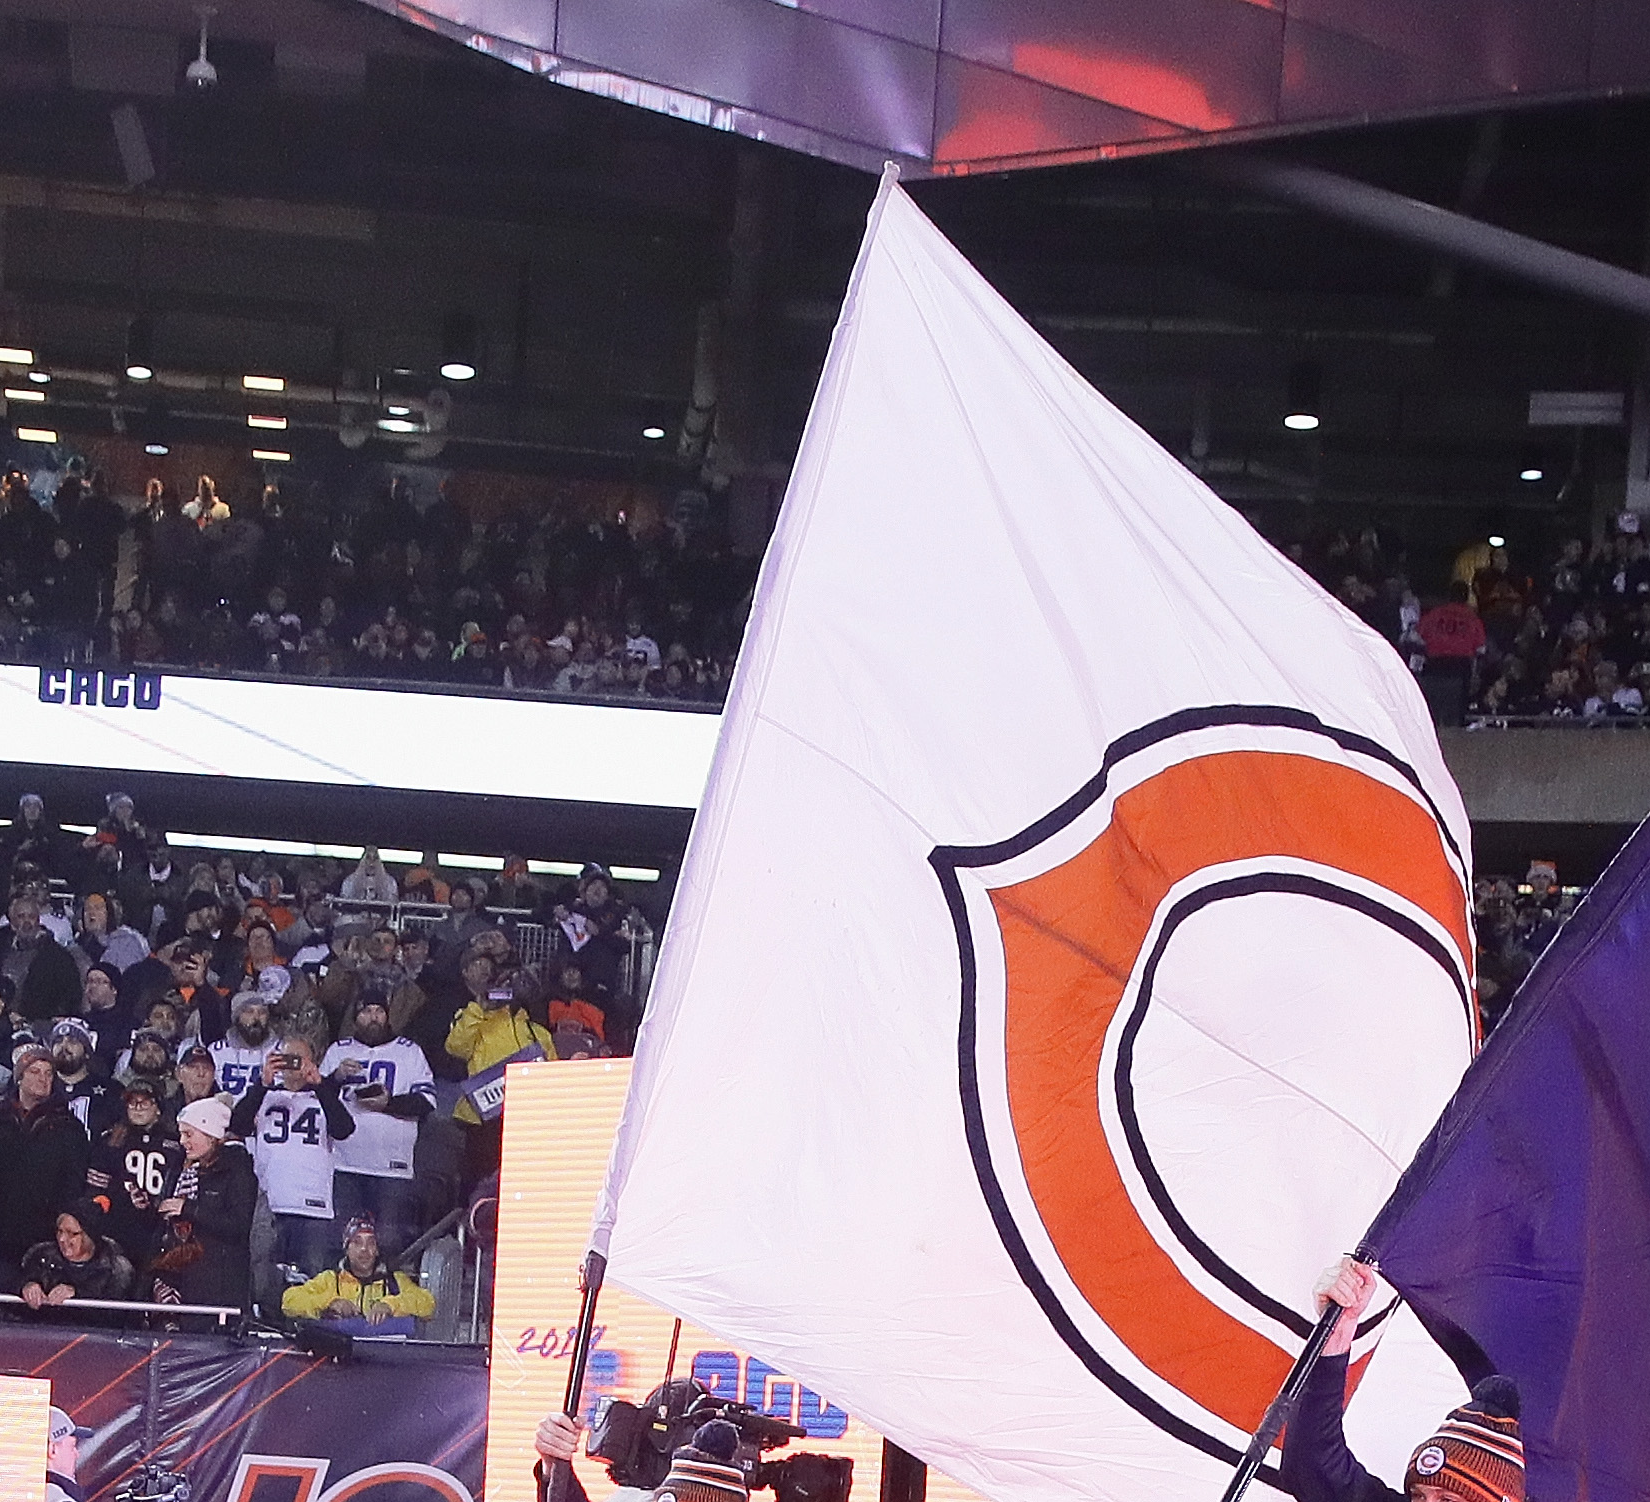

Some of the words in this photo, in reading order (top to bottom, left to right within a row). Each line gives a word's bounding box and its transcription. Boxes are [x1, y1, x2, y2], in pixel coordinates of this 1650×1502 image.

[39, 669, 161, 709] CAGO
[263, 1106, 321, 1145] 34
[124, 1149, 166, 1196] 96
